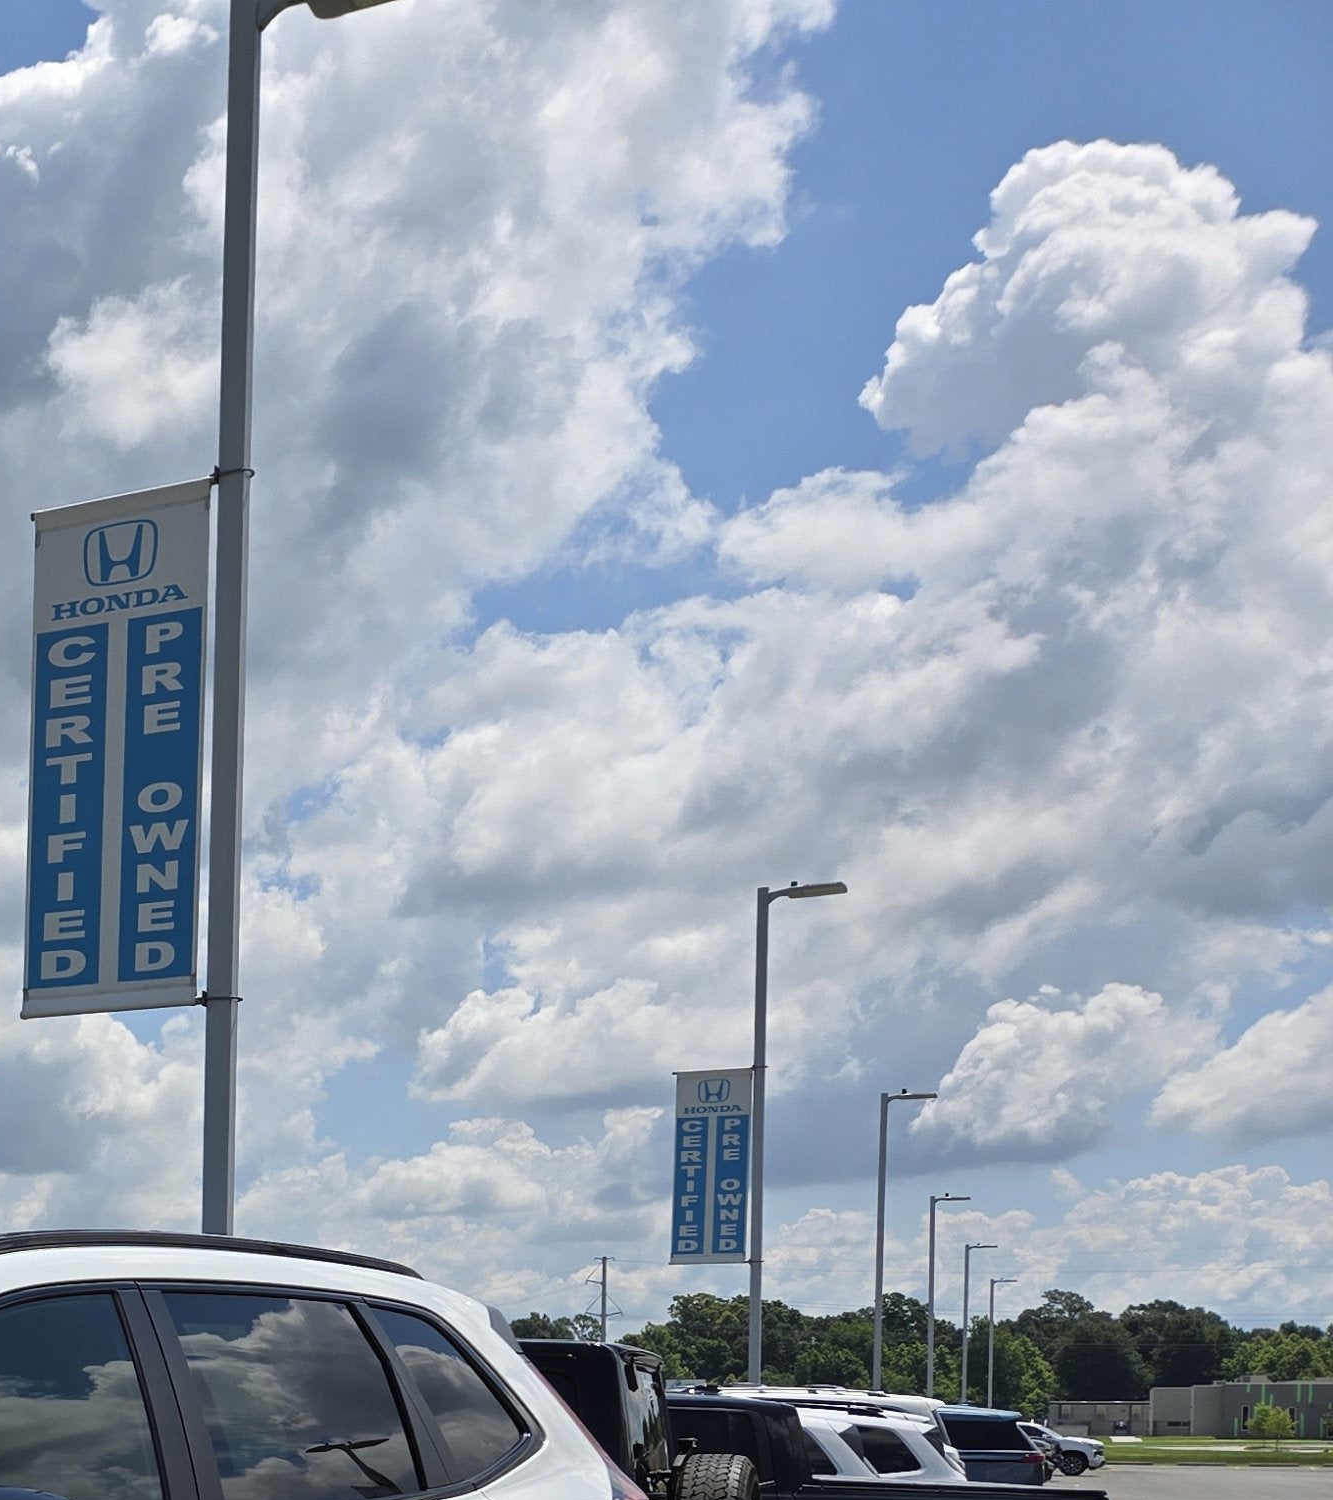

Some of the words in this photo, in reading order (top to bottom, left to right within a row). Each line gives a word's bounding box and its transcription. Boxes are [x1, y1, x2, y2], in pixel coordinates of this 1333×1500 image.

[51, 584, 189, 621] HONDA
[141, 621, 184, 735] PRE
[39, 636, 96, 981] CERTIFIED
[129, 781, 189, 973] OWNED
[684, 1104, 742, 1114] HONDA
[722, 1118, 741, 1161] PRE
[678, 1120, 703, 1251] CERTIFIED
[717, 1178, 742, 1251] OWNED
